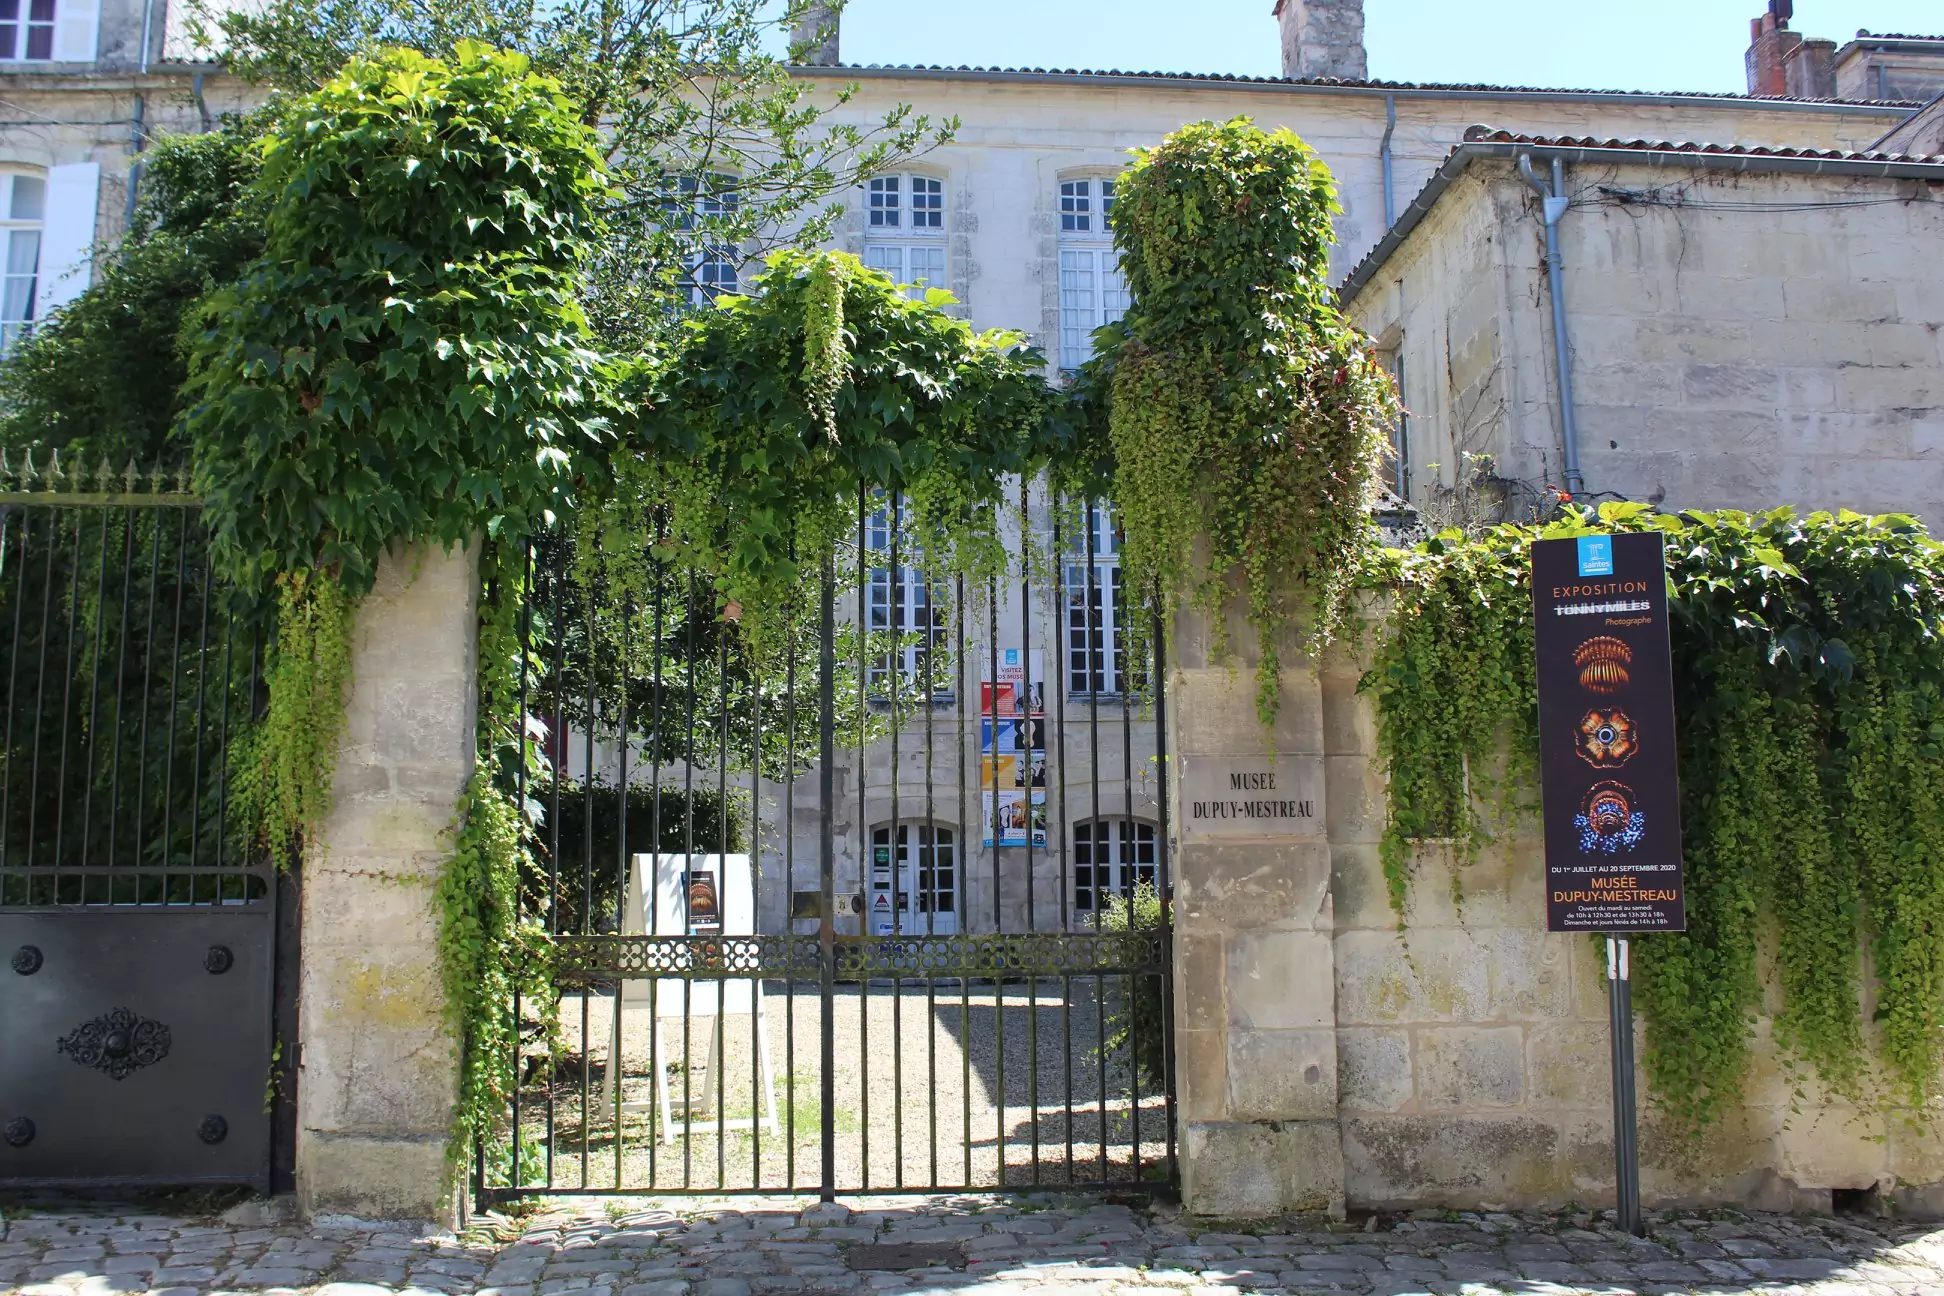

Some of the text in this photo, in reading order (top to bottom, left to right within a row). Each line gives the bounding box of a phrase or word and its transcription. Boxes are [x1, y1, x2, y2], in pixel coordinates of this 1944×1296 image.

[1553, 581, 1647, 598] EXPOSITION
[1605, 616, 1652, 627] Photographe
[1193, 800, 1315, 819] DUPUY-MESTREAU
[1591, 875, 1637, 889] MUSÉE
[1554, 890, 1677, 903] DUPUY-MESTREAU
[1599, 919, 1613, 927] jours
